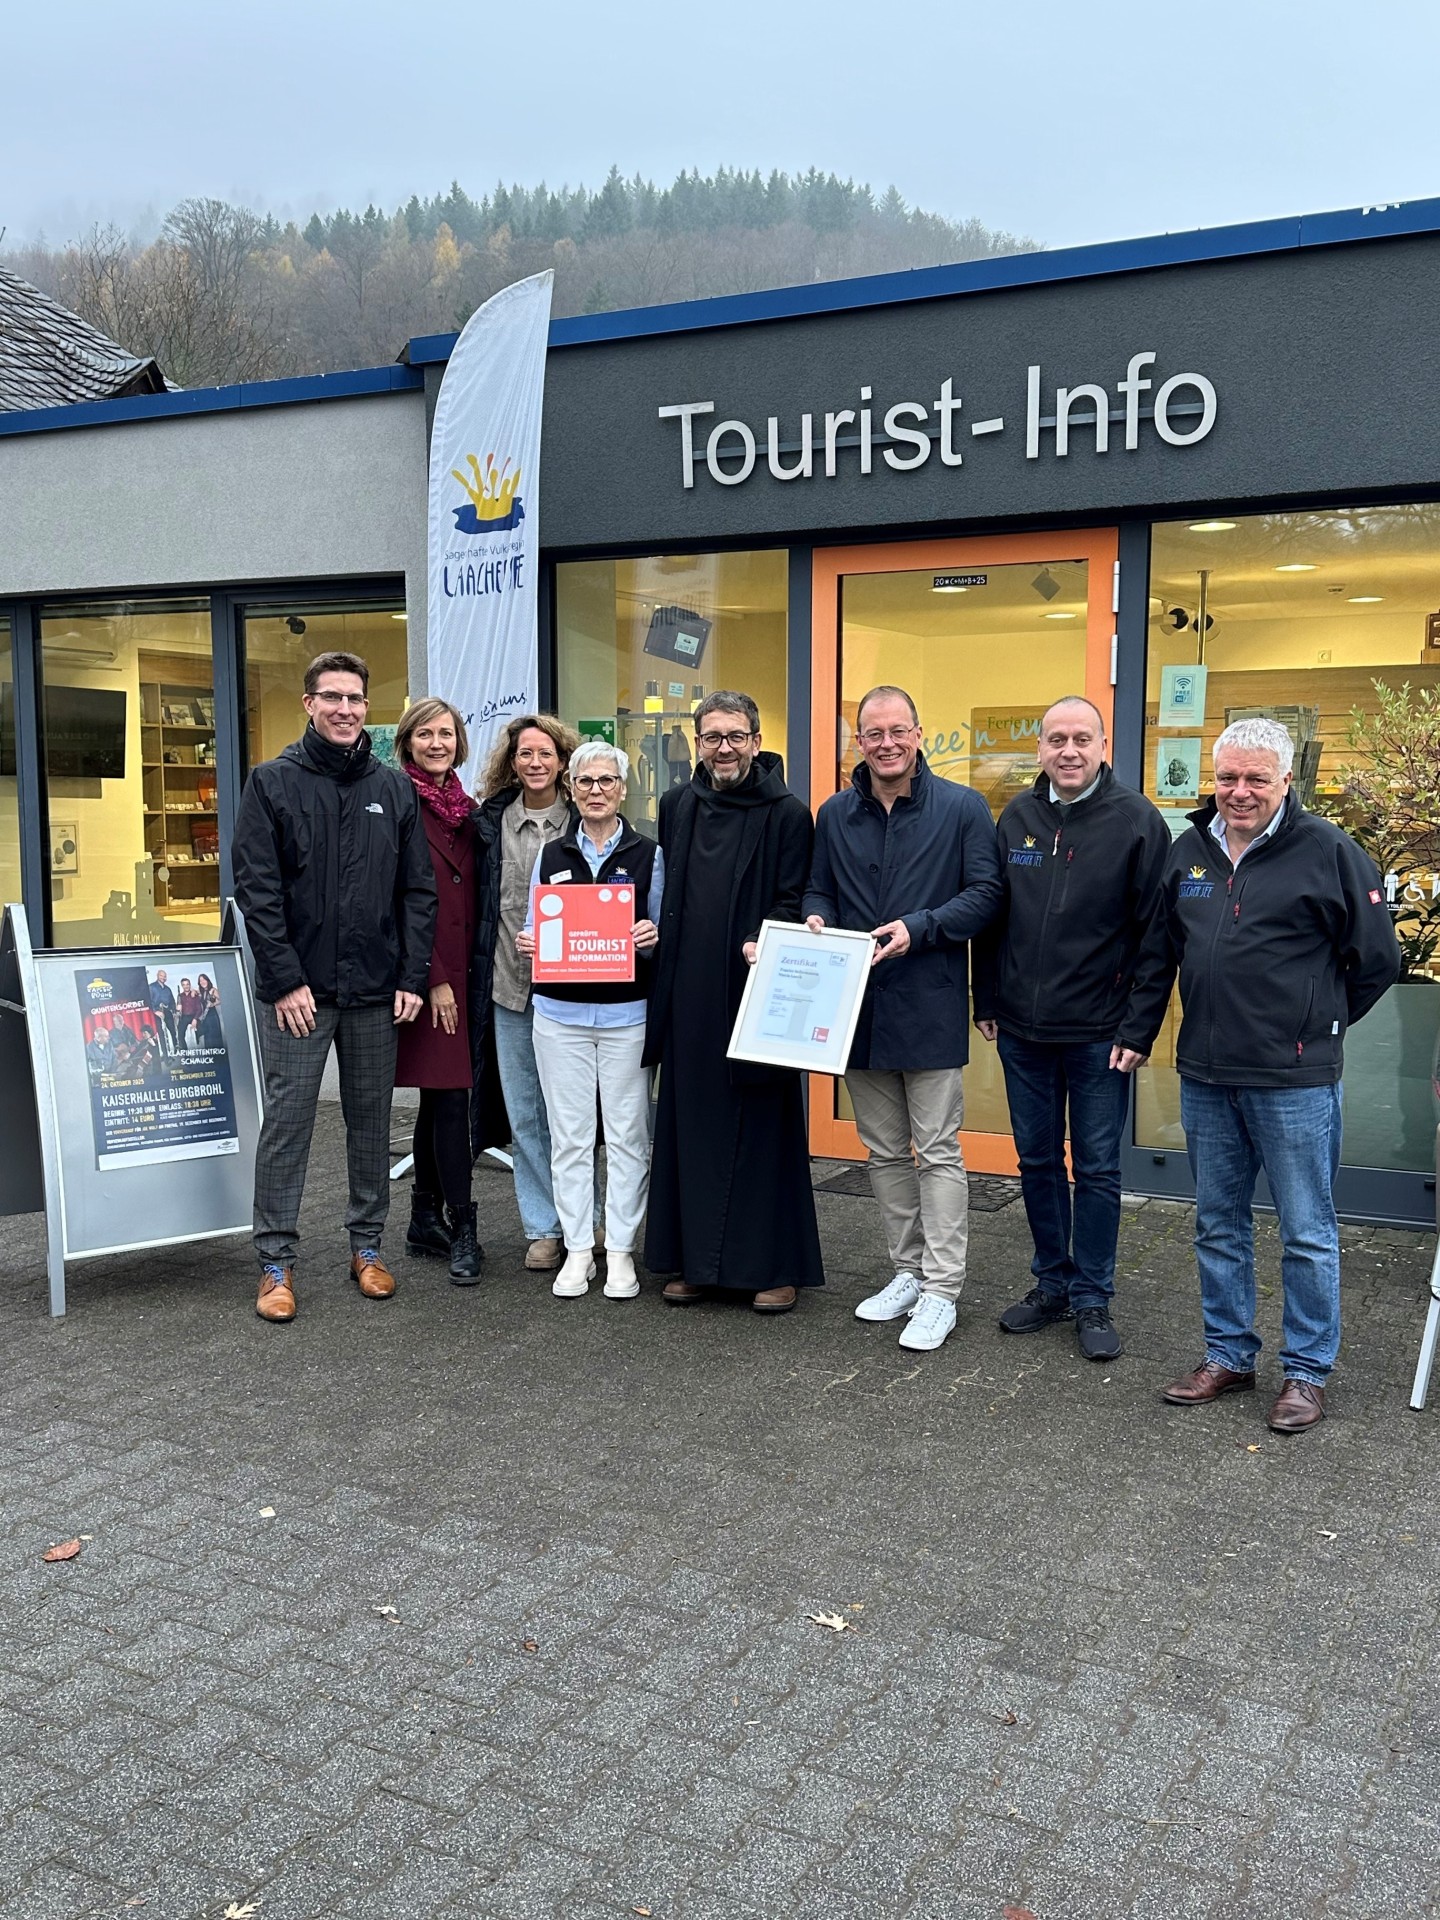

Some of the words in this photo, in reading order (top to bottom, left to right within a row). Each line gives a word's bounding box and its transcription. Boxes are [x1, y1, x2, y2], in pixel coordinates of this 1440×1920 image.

[658, 351, 1218, 488] Tourist-Info
[568, 939, 628, 952] TOURIST
[568, 954, 628, 962] INFORMATION
[780, 956, 818, 968] Zertifikat
[180, 1057, 215, 1066] SCHMUCK
[180, 1072, 204, 1080] NOVEMBER
[110, 1079, 132, 1088] OKTOBER
[132, 1078, 145, 1086] 2025
[102, 1089, 166, 1107] KAISERHALLE
[169, 1083, 224, 1100] BURGBROHL
[127, 1107, 143, 1115] 19:30
[144, 1106, 156, 1114] UHR
[158, 1102, 183, 1112] EINLASS:
[200, 1099, 212, 1107] UHR
[131, 1116, 139, 1124] 14
[140, 1114, 155, 1123] EURO
